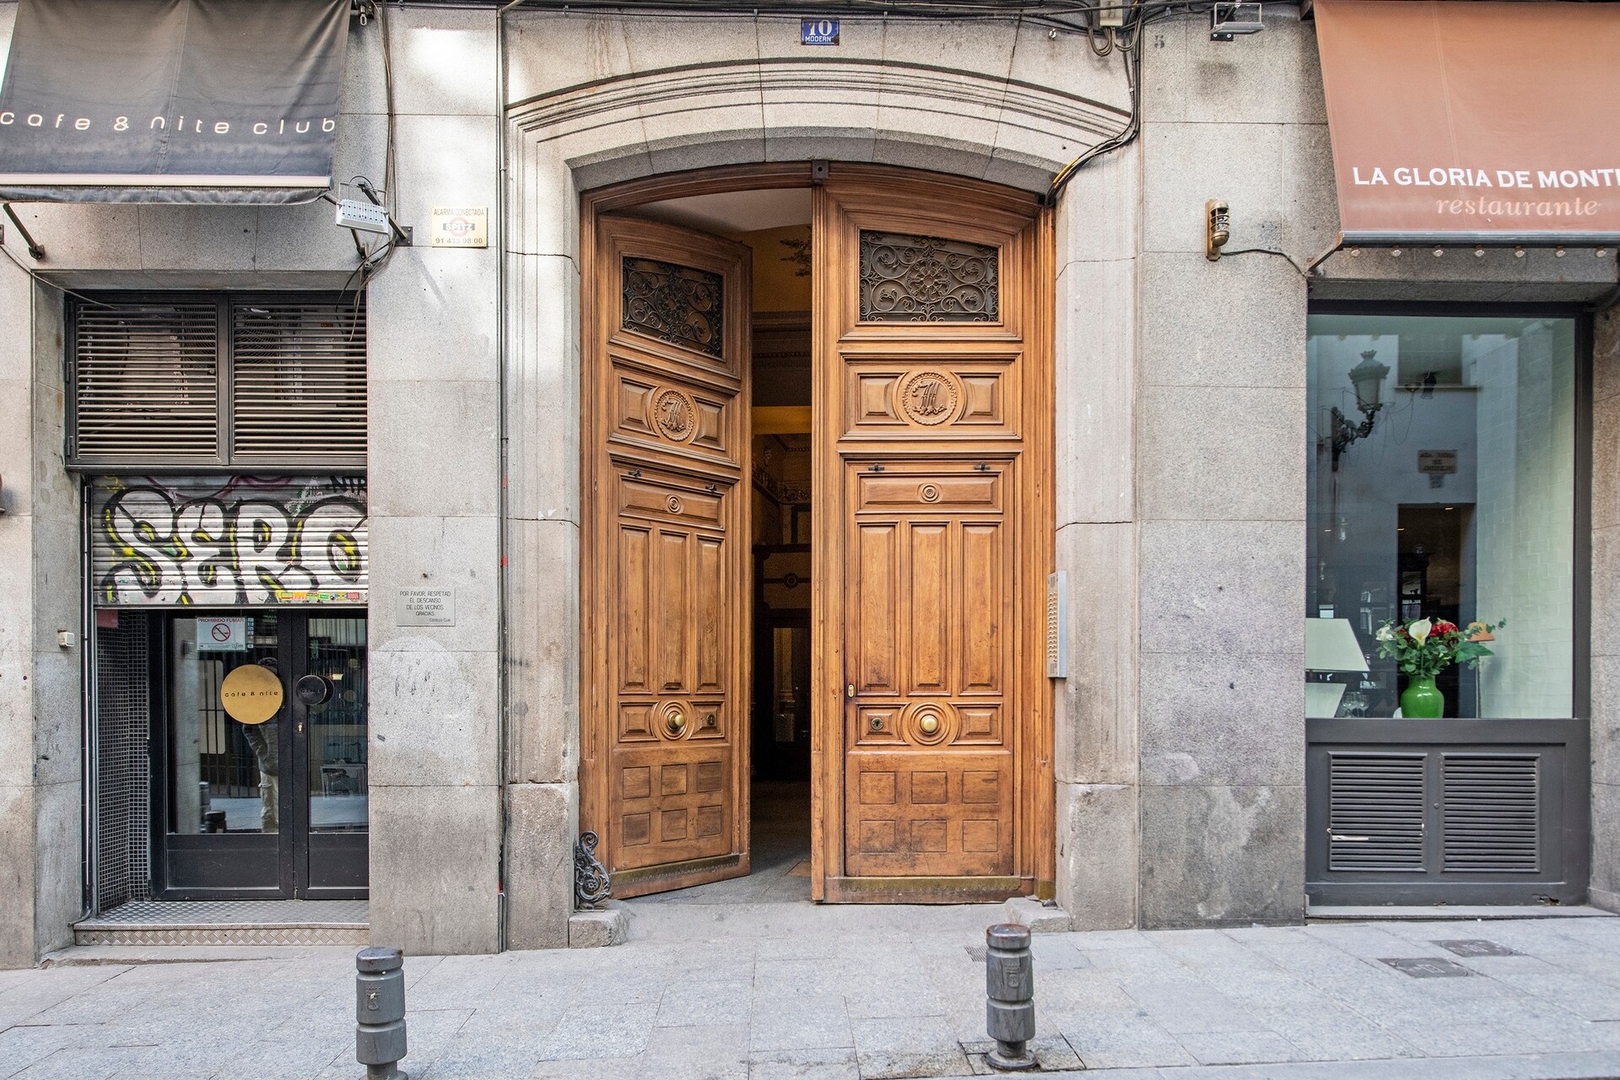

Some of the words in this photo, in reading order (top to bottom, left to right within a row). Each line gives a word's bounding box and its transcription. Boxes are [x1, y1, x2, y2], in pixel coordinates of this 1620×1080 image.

[0, 110, 91, 131] cafe
[113, 116, 129, 132] &
[150, 115, 230, 134] nite
[253, 117, 335, 135] club
[1352, 166, 1389, 186] LA
[1393, 167, 1493, 188] GLORIA
[1496, 170, 1533, 189] DE
[433, 208, 454, 216] ALARMA
[1436, 196, 1600, 217] restaurante
